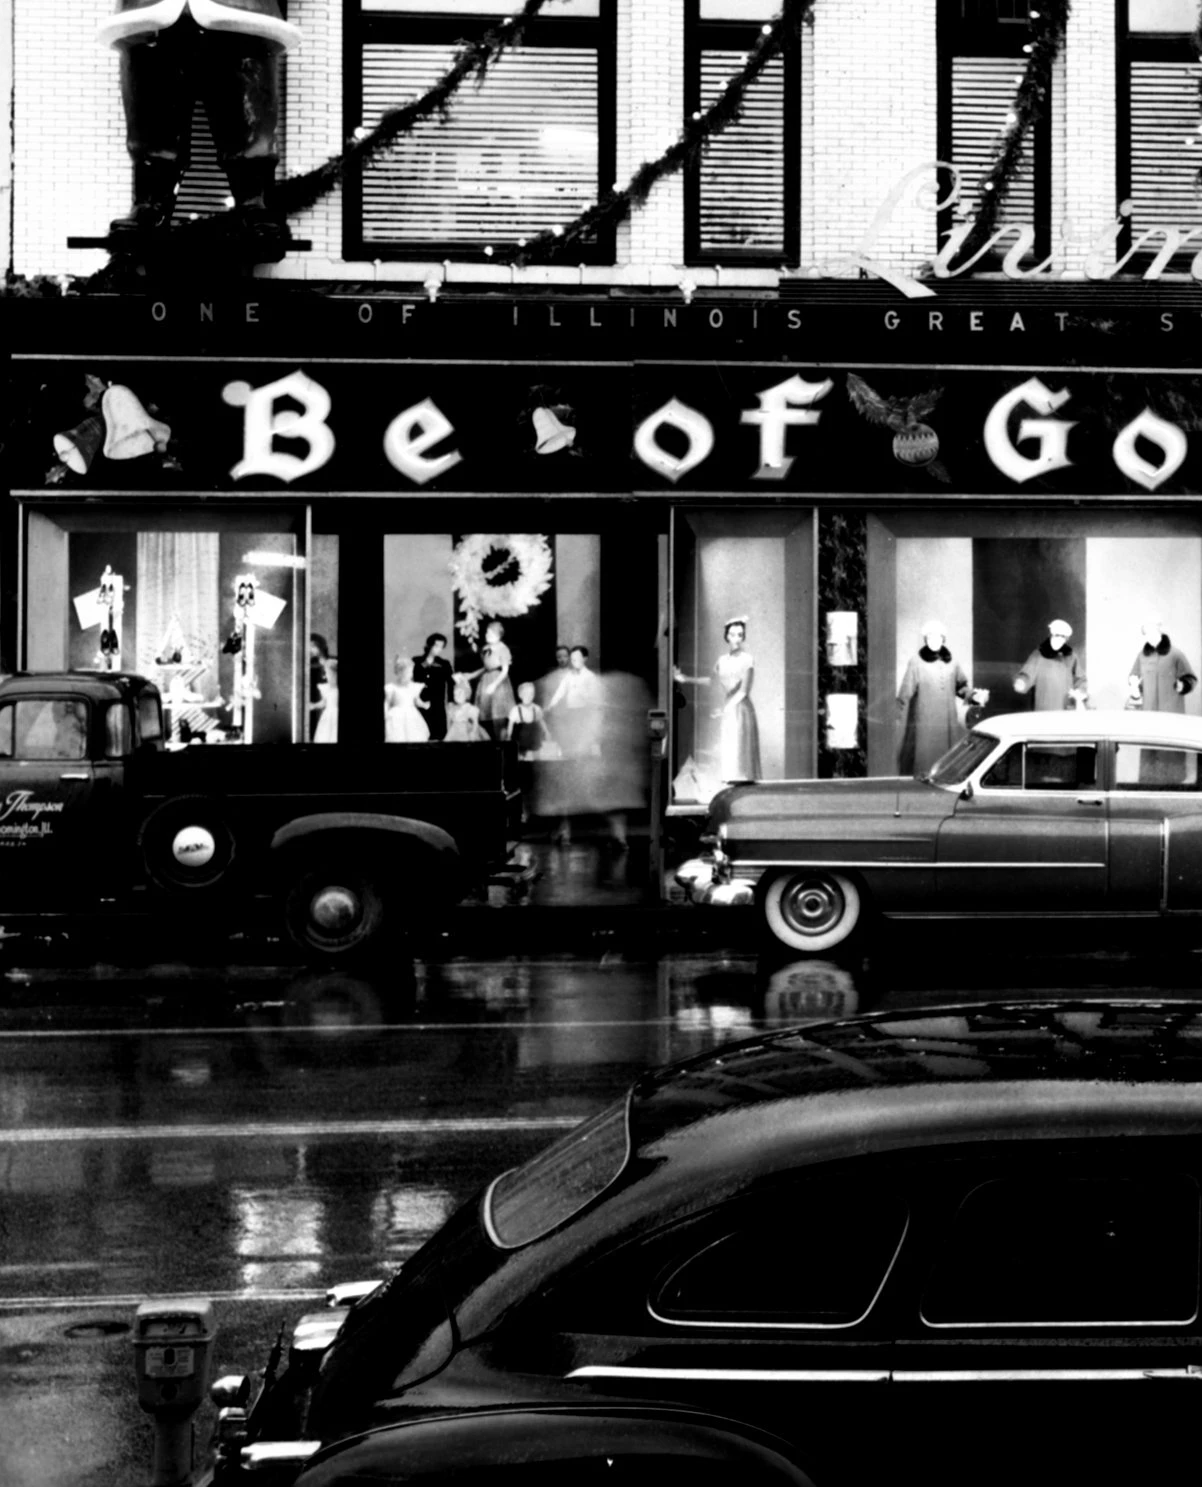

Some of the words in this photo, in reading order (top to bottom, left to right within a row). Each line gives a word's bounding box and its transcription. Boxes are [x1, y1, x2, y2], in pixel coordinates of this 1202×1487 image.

[152, 302, 258, 322] ONE
[358, 304, 415, 324] OF
[513, 305, 801, 329] ILLINOIS
[885, 310, 1069, 332] GREAT
[222, 370, 461, 484] Be
[634, 375, 832, 480] of
[0, 790, 64, 823] Thompson
